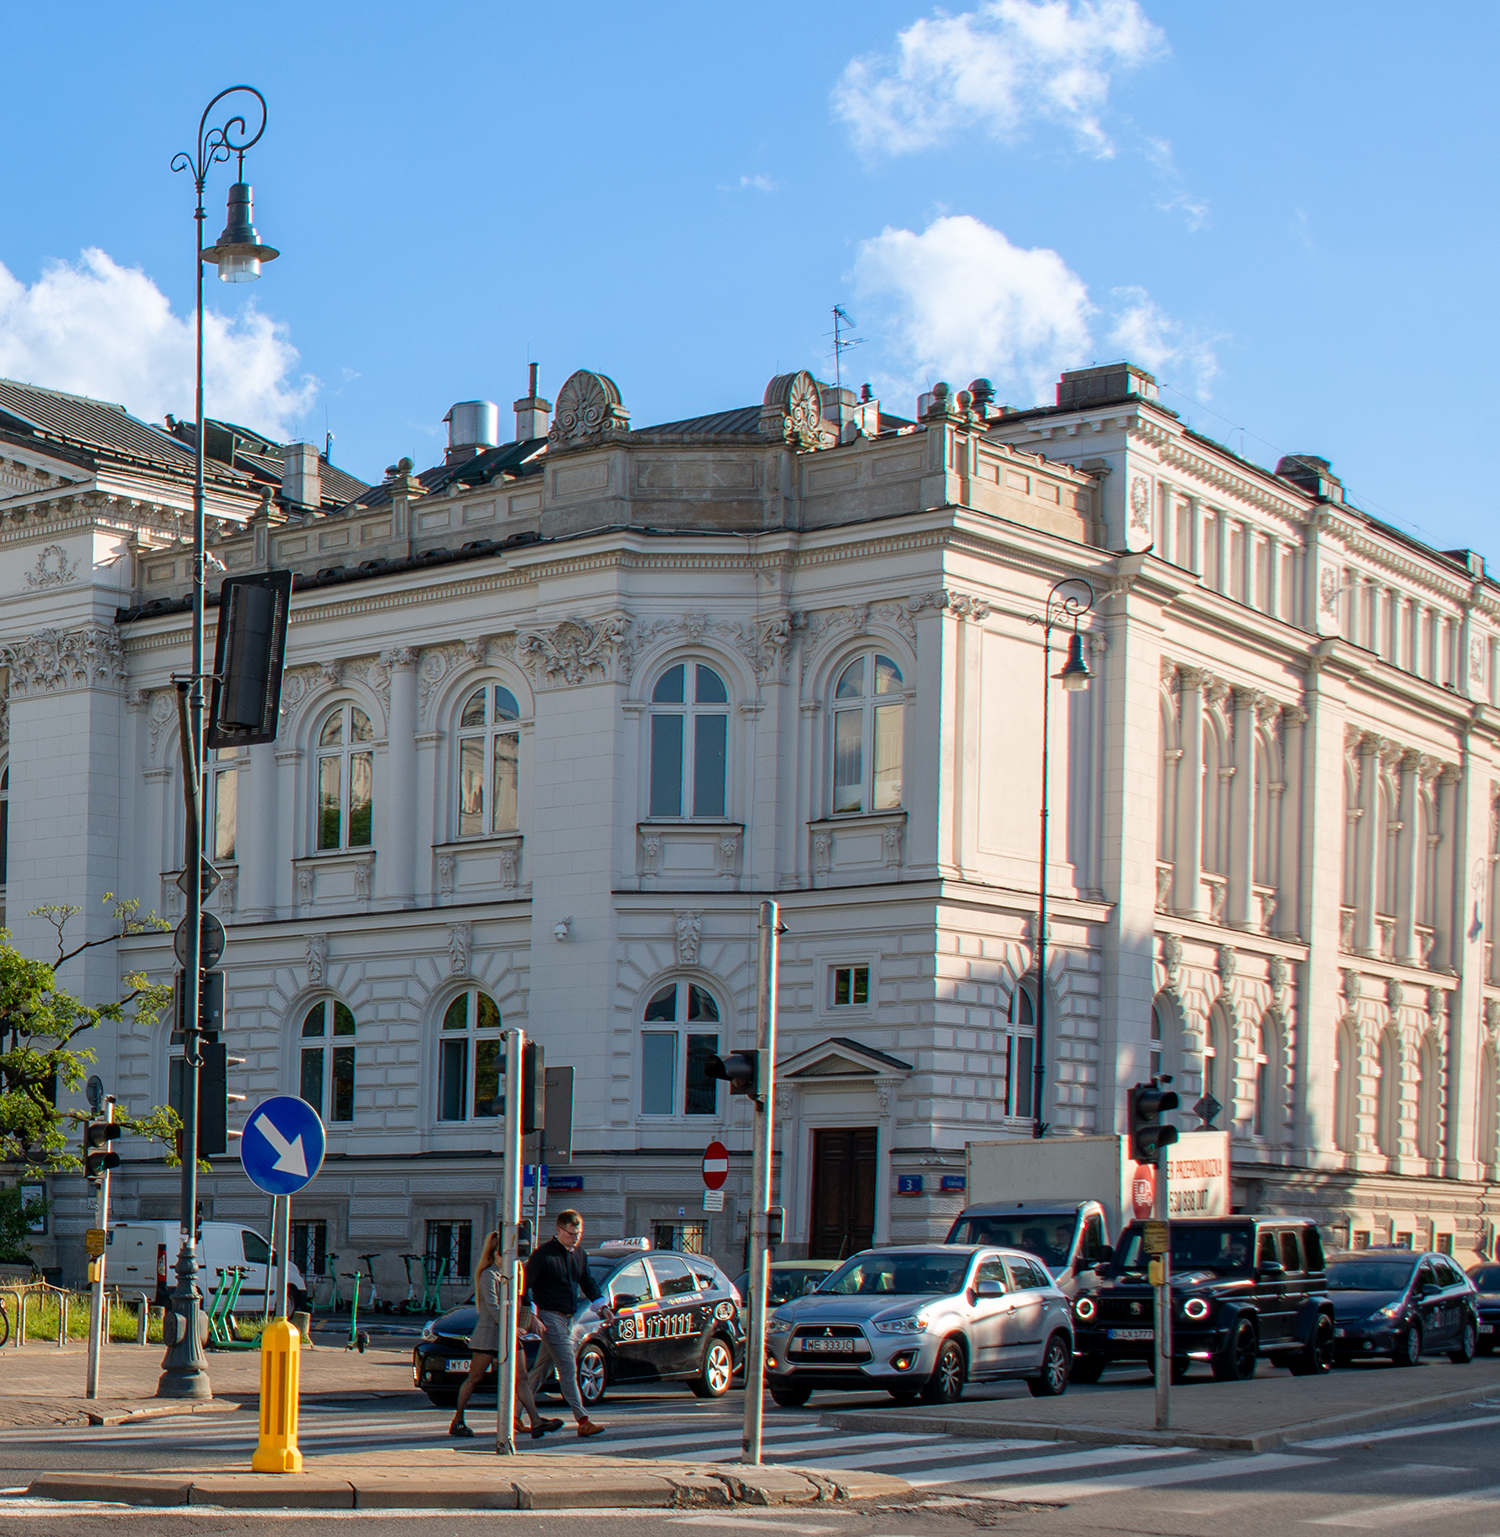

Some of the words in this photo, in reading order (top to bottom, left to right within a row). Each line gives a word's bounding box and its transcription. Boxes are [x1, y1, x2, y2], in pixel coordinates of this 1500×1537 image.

[905, 1179, 913, 1191] 3
[623, 1238, 642, 1246] TAXI
[807, 1340, 821, 1350] WE
[823, 1340, 852, 1350] 333JC
[450, 1360, 462, 1370] WY
